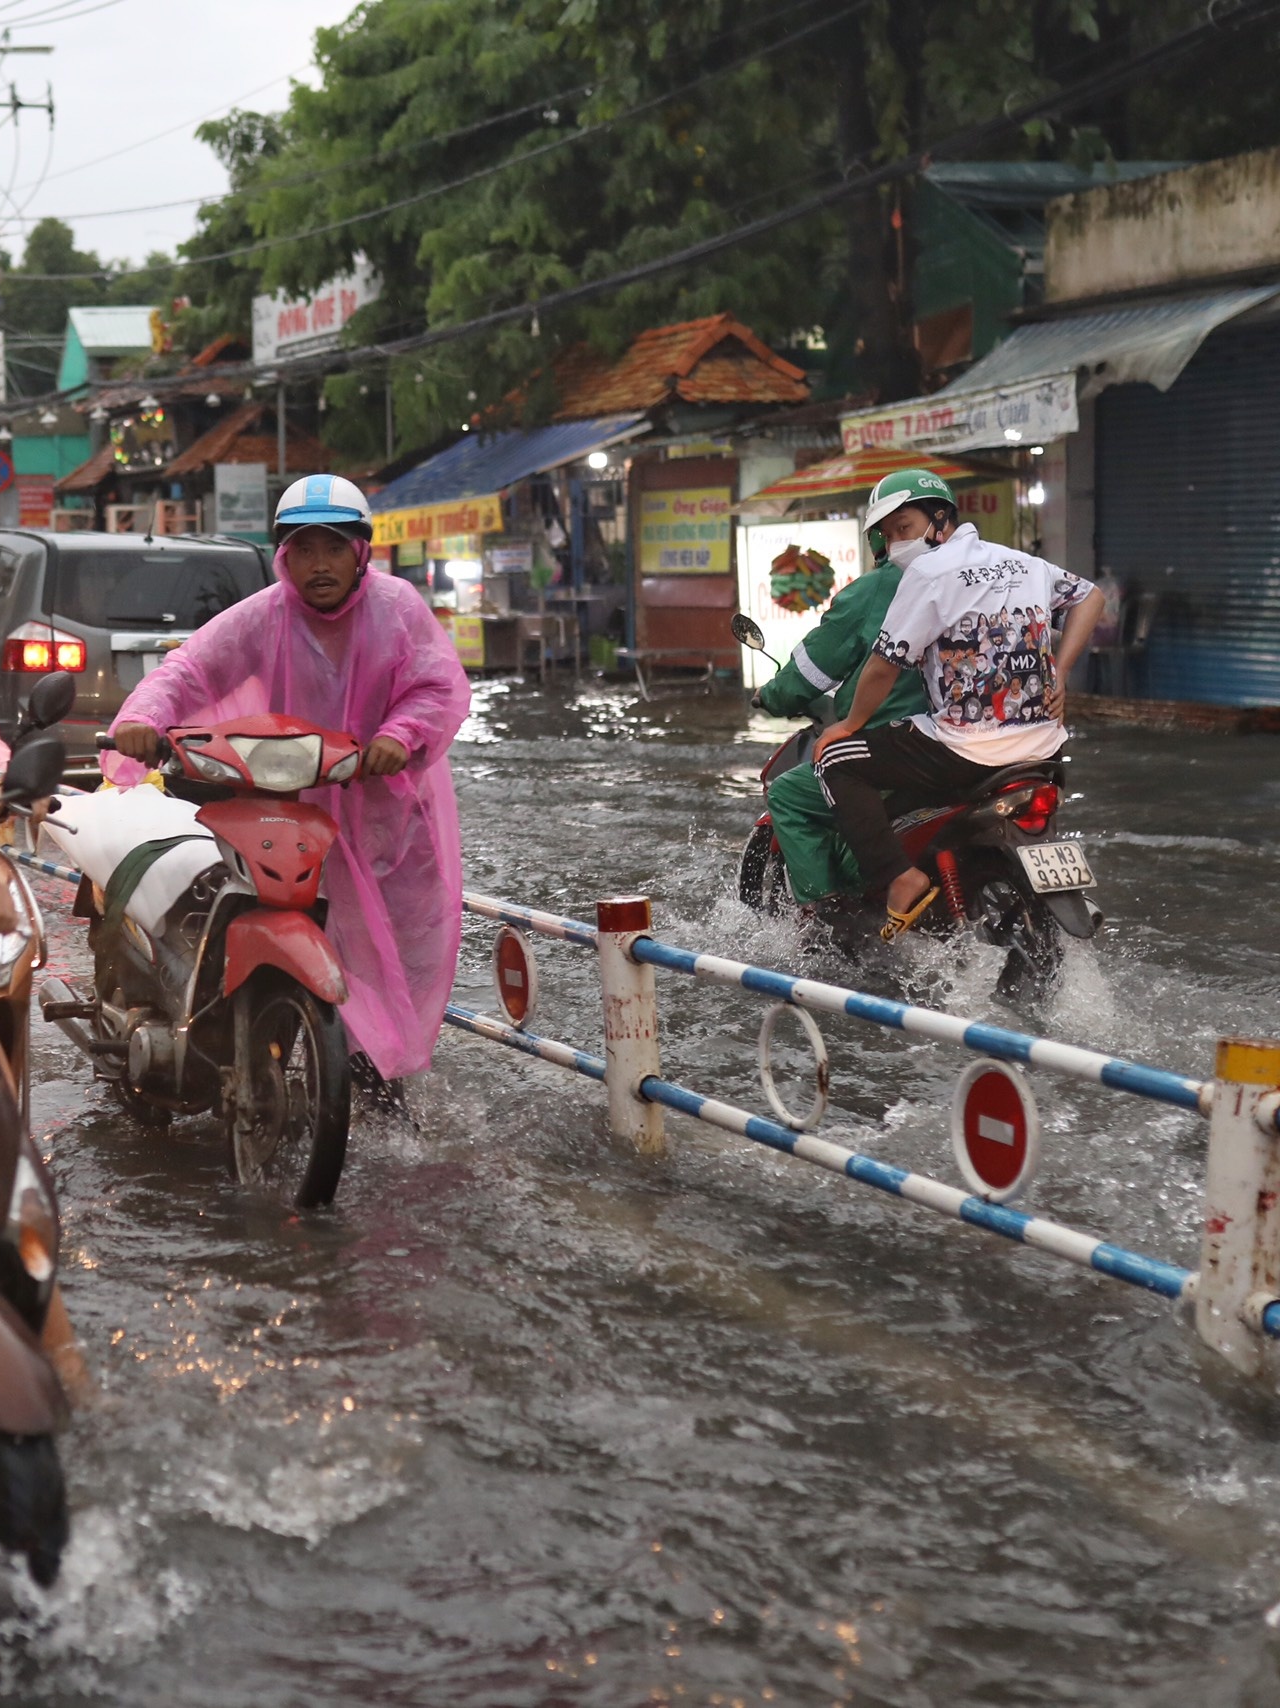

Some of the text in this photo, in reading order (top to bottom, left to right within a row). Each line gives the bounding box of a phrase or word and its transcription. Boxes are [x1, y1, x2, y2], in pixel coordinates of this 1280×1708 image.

[918, 478, 948, 492] Grab
[259, 817, 300, 825] HONDA
[1028, 846, 1077, 868] 54-N3
